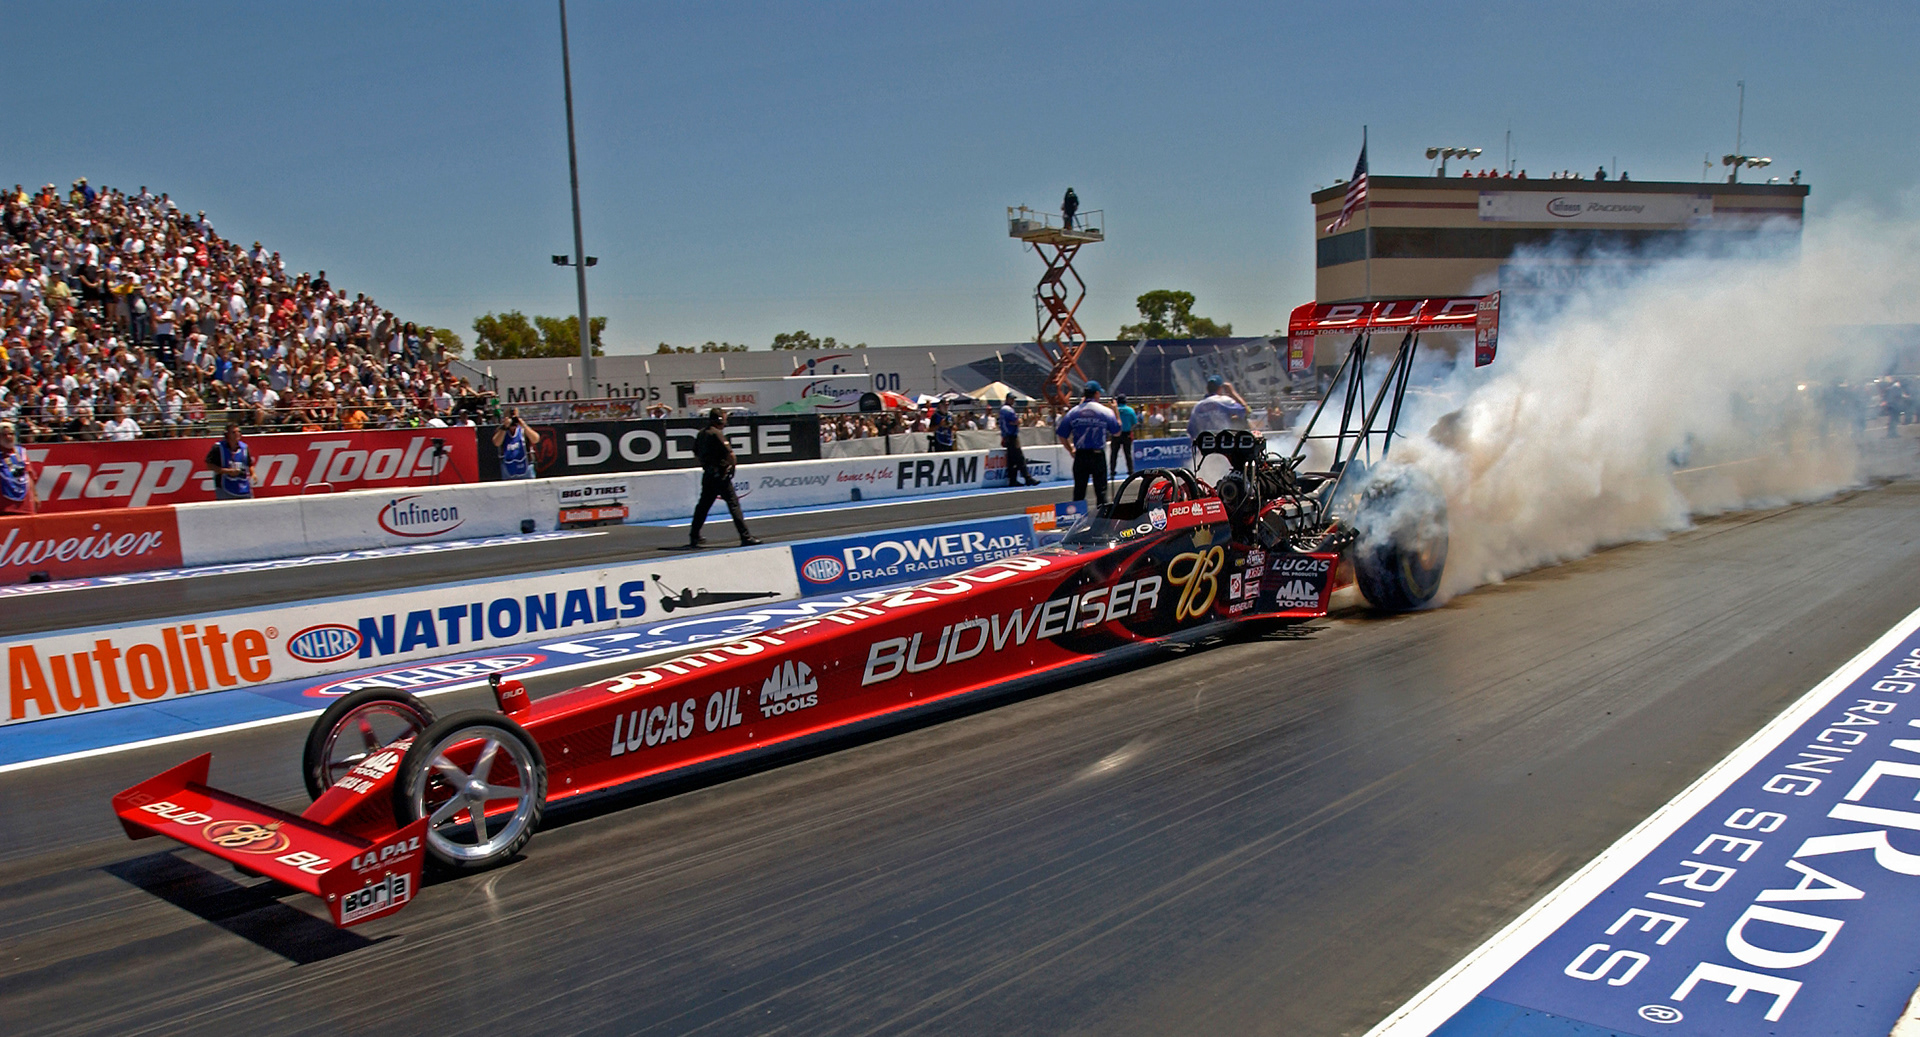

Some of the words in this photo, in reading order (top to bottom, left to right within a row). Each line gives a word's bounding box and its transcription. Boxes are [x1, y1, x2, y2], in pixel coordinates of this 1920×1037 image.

[507, 385, 578, 403] Micro
[598, 383, 661, 401] hips
[565, 424, 793, 466] DODGE
[1201, 435, 1255, 449] BUD
[27, 448, 299, 508] nap-n
[306, 436, 453, 485] Tools
[760, 475, 830, 489] RACEWAY
[836, 470, 863, 483] home
[865, 468, 877, 484] of
[878, 467, 893, 479] the
[896, 456, 979, 490] FRAM
[562, 488, 582, 499] BIG
[594, 485, 627, 495] TIRES
[1171, 505, 1191, 516] BUD
[806, 558, 841, 581] NHRA
[848, 566, 899, 582] DRAG
[905, 556, 969, 573] RACING
[973, 547, 1028, 563] SERIES
[1271, 559, 1331, 572] LUCAS
[1276, 579, 1319, 600] MAC
[1276, 600, 1319, 608] TOOLS
[297, 627, 359, 659] NHRA
[358, 580, 647, 660] NATIONALS
[861, 575, 1163, 687] BUDWEISER
[7, 624, 273, 720] Autolite
[759, 660, 819, 706] MAC
[1871, 648, 1920, 694] DRAG
[502, 687, 525, 700] BUD
[760, 694, 819, 718] TOOLS
[610, 698, 697, 757] LUCAS
[704, 686, 743, 733] OIL
[1762, 699, 1897, 797] RACING
[353, 767, 386, 779] TOOLS
[359, 751, 400, 774] MAC
[139, 801, 213, 826] BUD
[351, 850, 378, 870] LA
[380, 836, 422, 861] PAZ
[1564, 808, 1788, 987] SERIES
